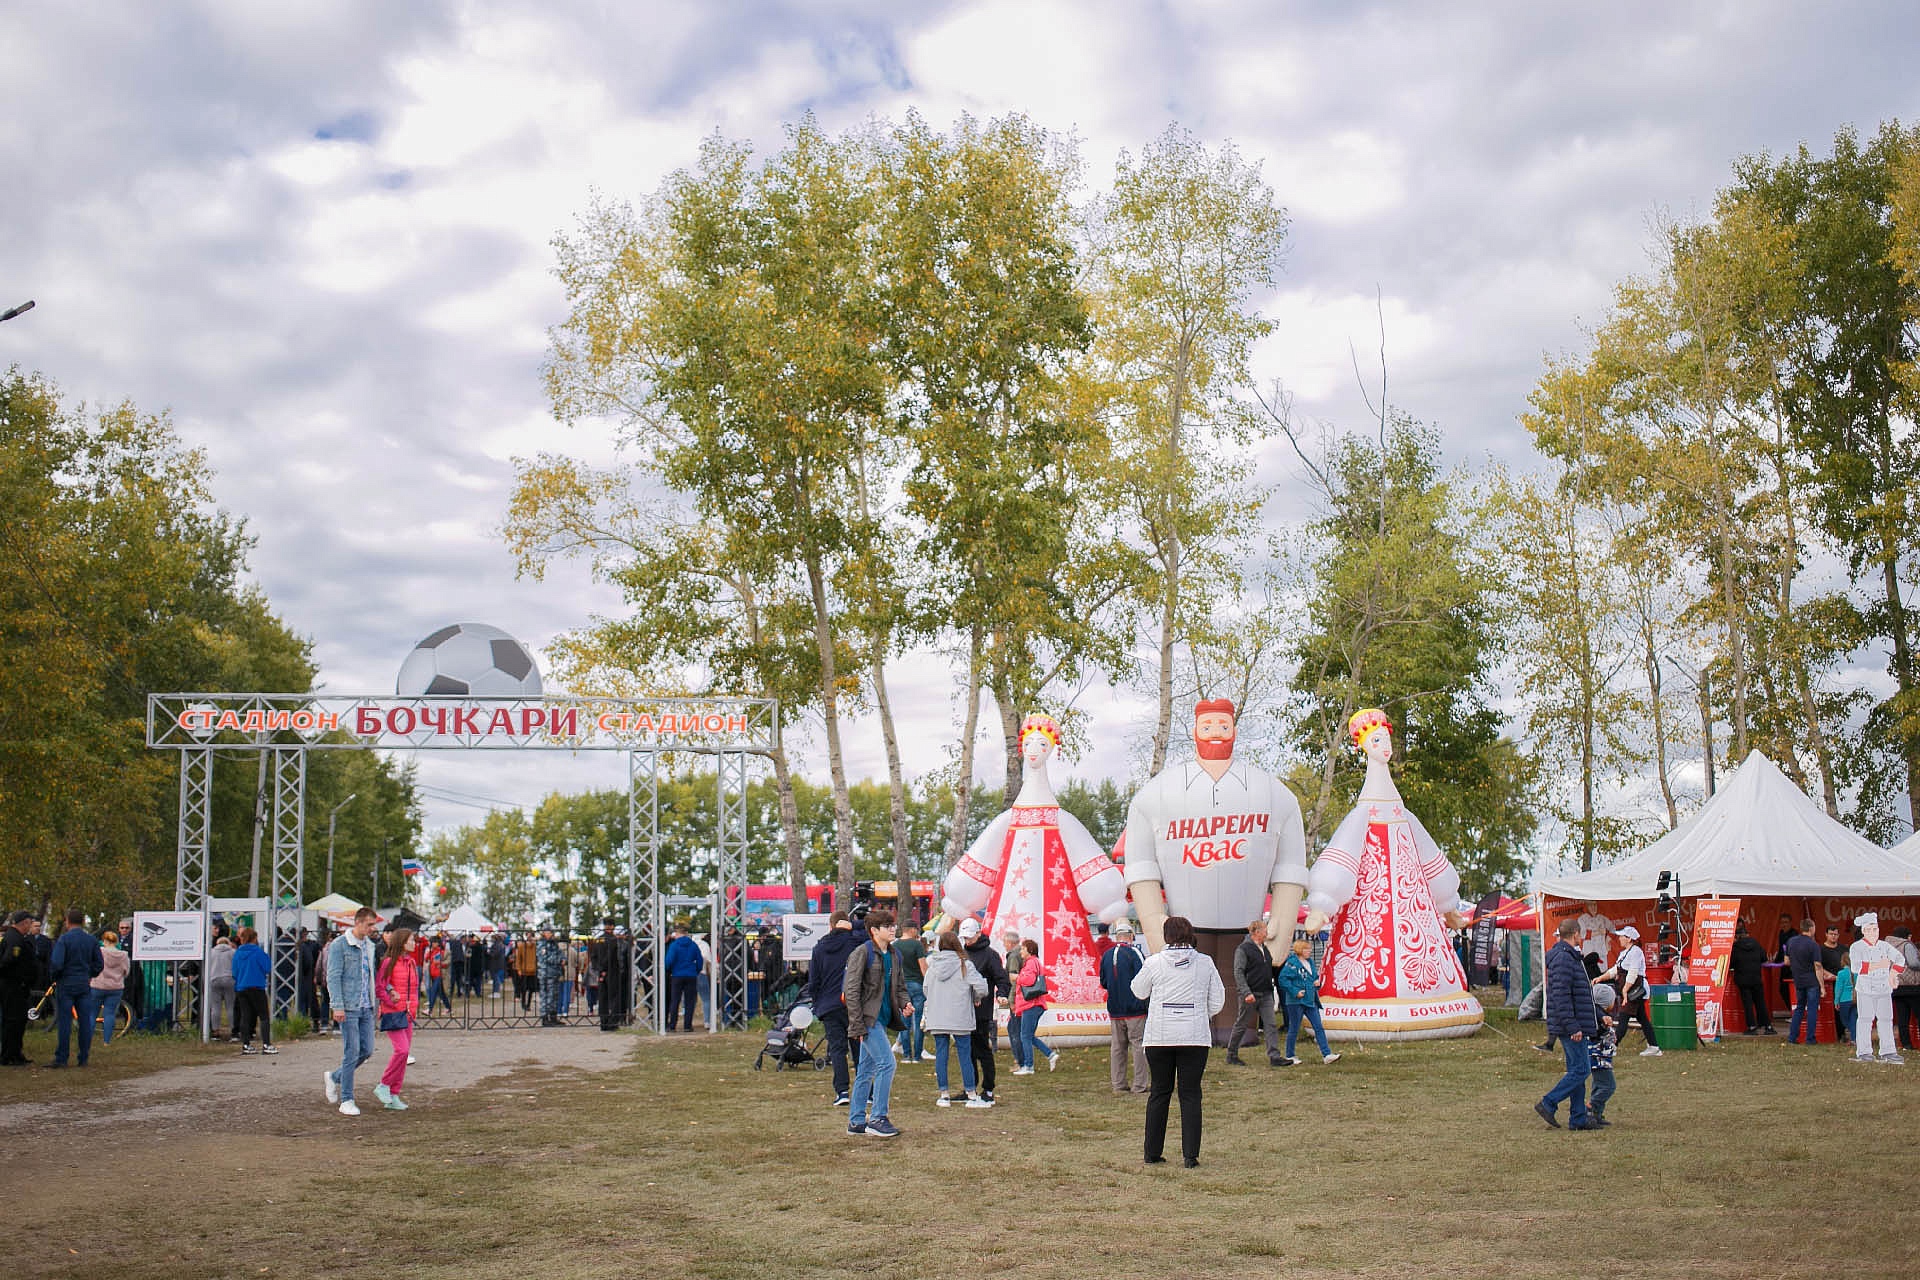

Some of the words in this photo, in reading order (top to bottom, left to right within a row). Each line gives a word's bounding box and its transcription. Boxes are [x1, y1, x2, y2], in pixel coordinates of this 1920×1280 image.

[178, 710, 338, 733] СТАДИОН
[356, 707, 577, 735] БОЧКАРИ
[598, 713, 747, 734] СТАДИОН
[1166, 813, 1270, 841] АНДРЕИЧ
[1055, 1012, 1111, 1022] БОЧКАР
[1325, 1007, 1388, 1018] БОЧКАРИ
[1410, 1002, 1468, 1017] БОЧКАРИ
